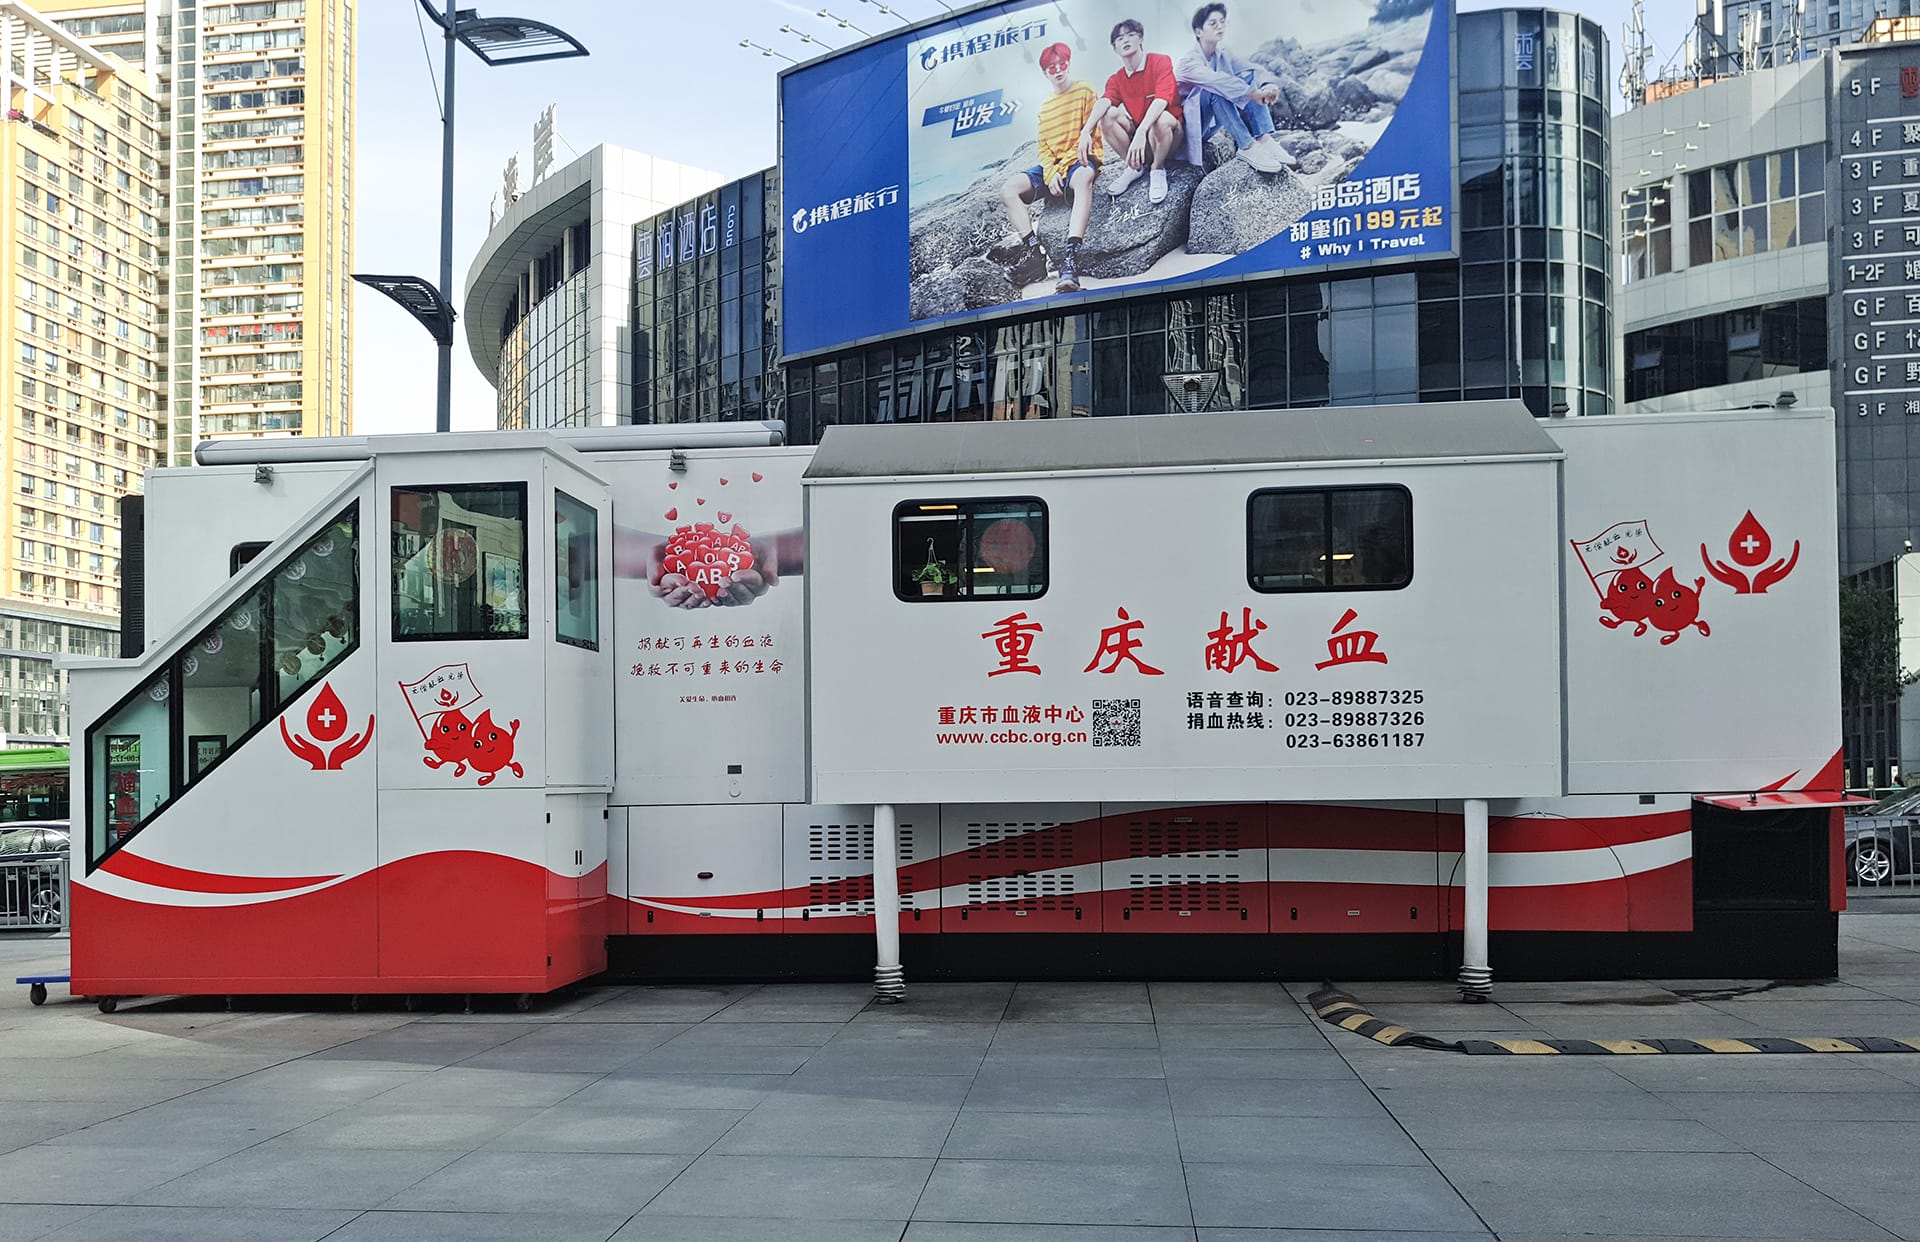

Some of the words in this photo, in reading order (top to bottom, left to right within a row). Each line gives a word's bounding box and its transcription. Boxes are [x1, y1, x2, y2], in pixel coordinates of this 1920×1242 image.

[941, 18, 1047, 64] 携程旅行
[1851, 77, 1881, 96] 5F
[955, 102, 995, 131] 出发
[1851, 128, 1882, 147] 4F
[1851, 160, 1882, 179] 3F
[1311, 173, 1421, 212] 海岛酒店
[809, 185, 899, 227] 携程旅行
[1852, 196, 1884, 215] 3F
[1317, 243, 1352, 256] Why
[1370, 233, 1426, 250] Travel
[1853, 230, 1884, 249] 3F
[1848, 263, 1885, 281] 1-2F
[1853, 297, 1886, 316] GF
[1854, 331, 1886, 350] GF
[1855, 365, 1887, 384] GF
[1859, 403, 1886, 416] 3F
[704, 553, 715, 565] O
[695, 568, 722, 584] AB
[637, 633, 774, 651] 捐献可再生的血液
[981, 607, 1389, 678] 重庆献血
[630, 658, 784, 677] 挽救不可重来的生命
[1284, 689, 1424, 706] 023-89887325
[938, 704, 1084, 725] 重庆市血液中心
[1285, 711, 1425, 728] 023-89887326
[936, 729, 1087, 746] www.ccbc.org.cn
[1286, 732, 1425, 749] 023-63861187
